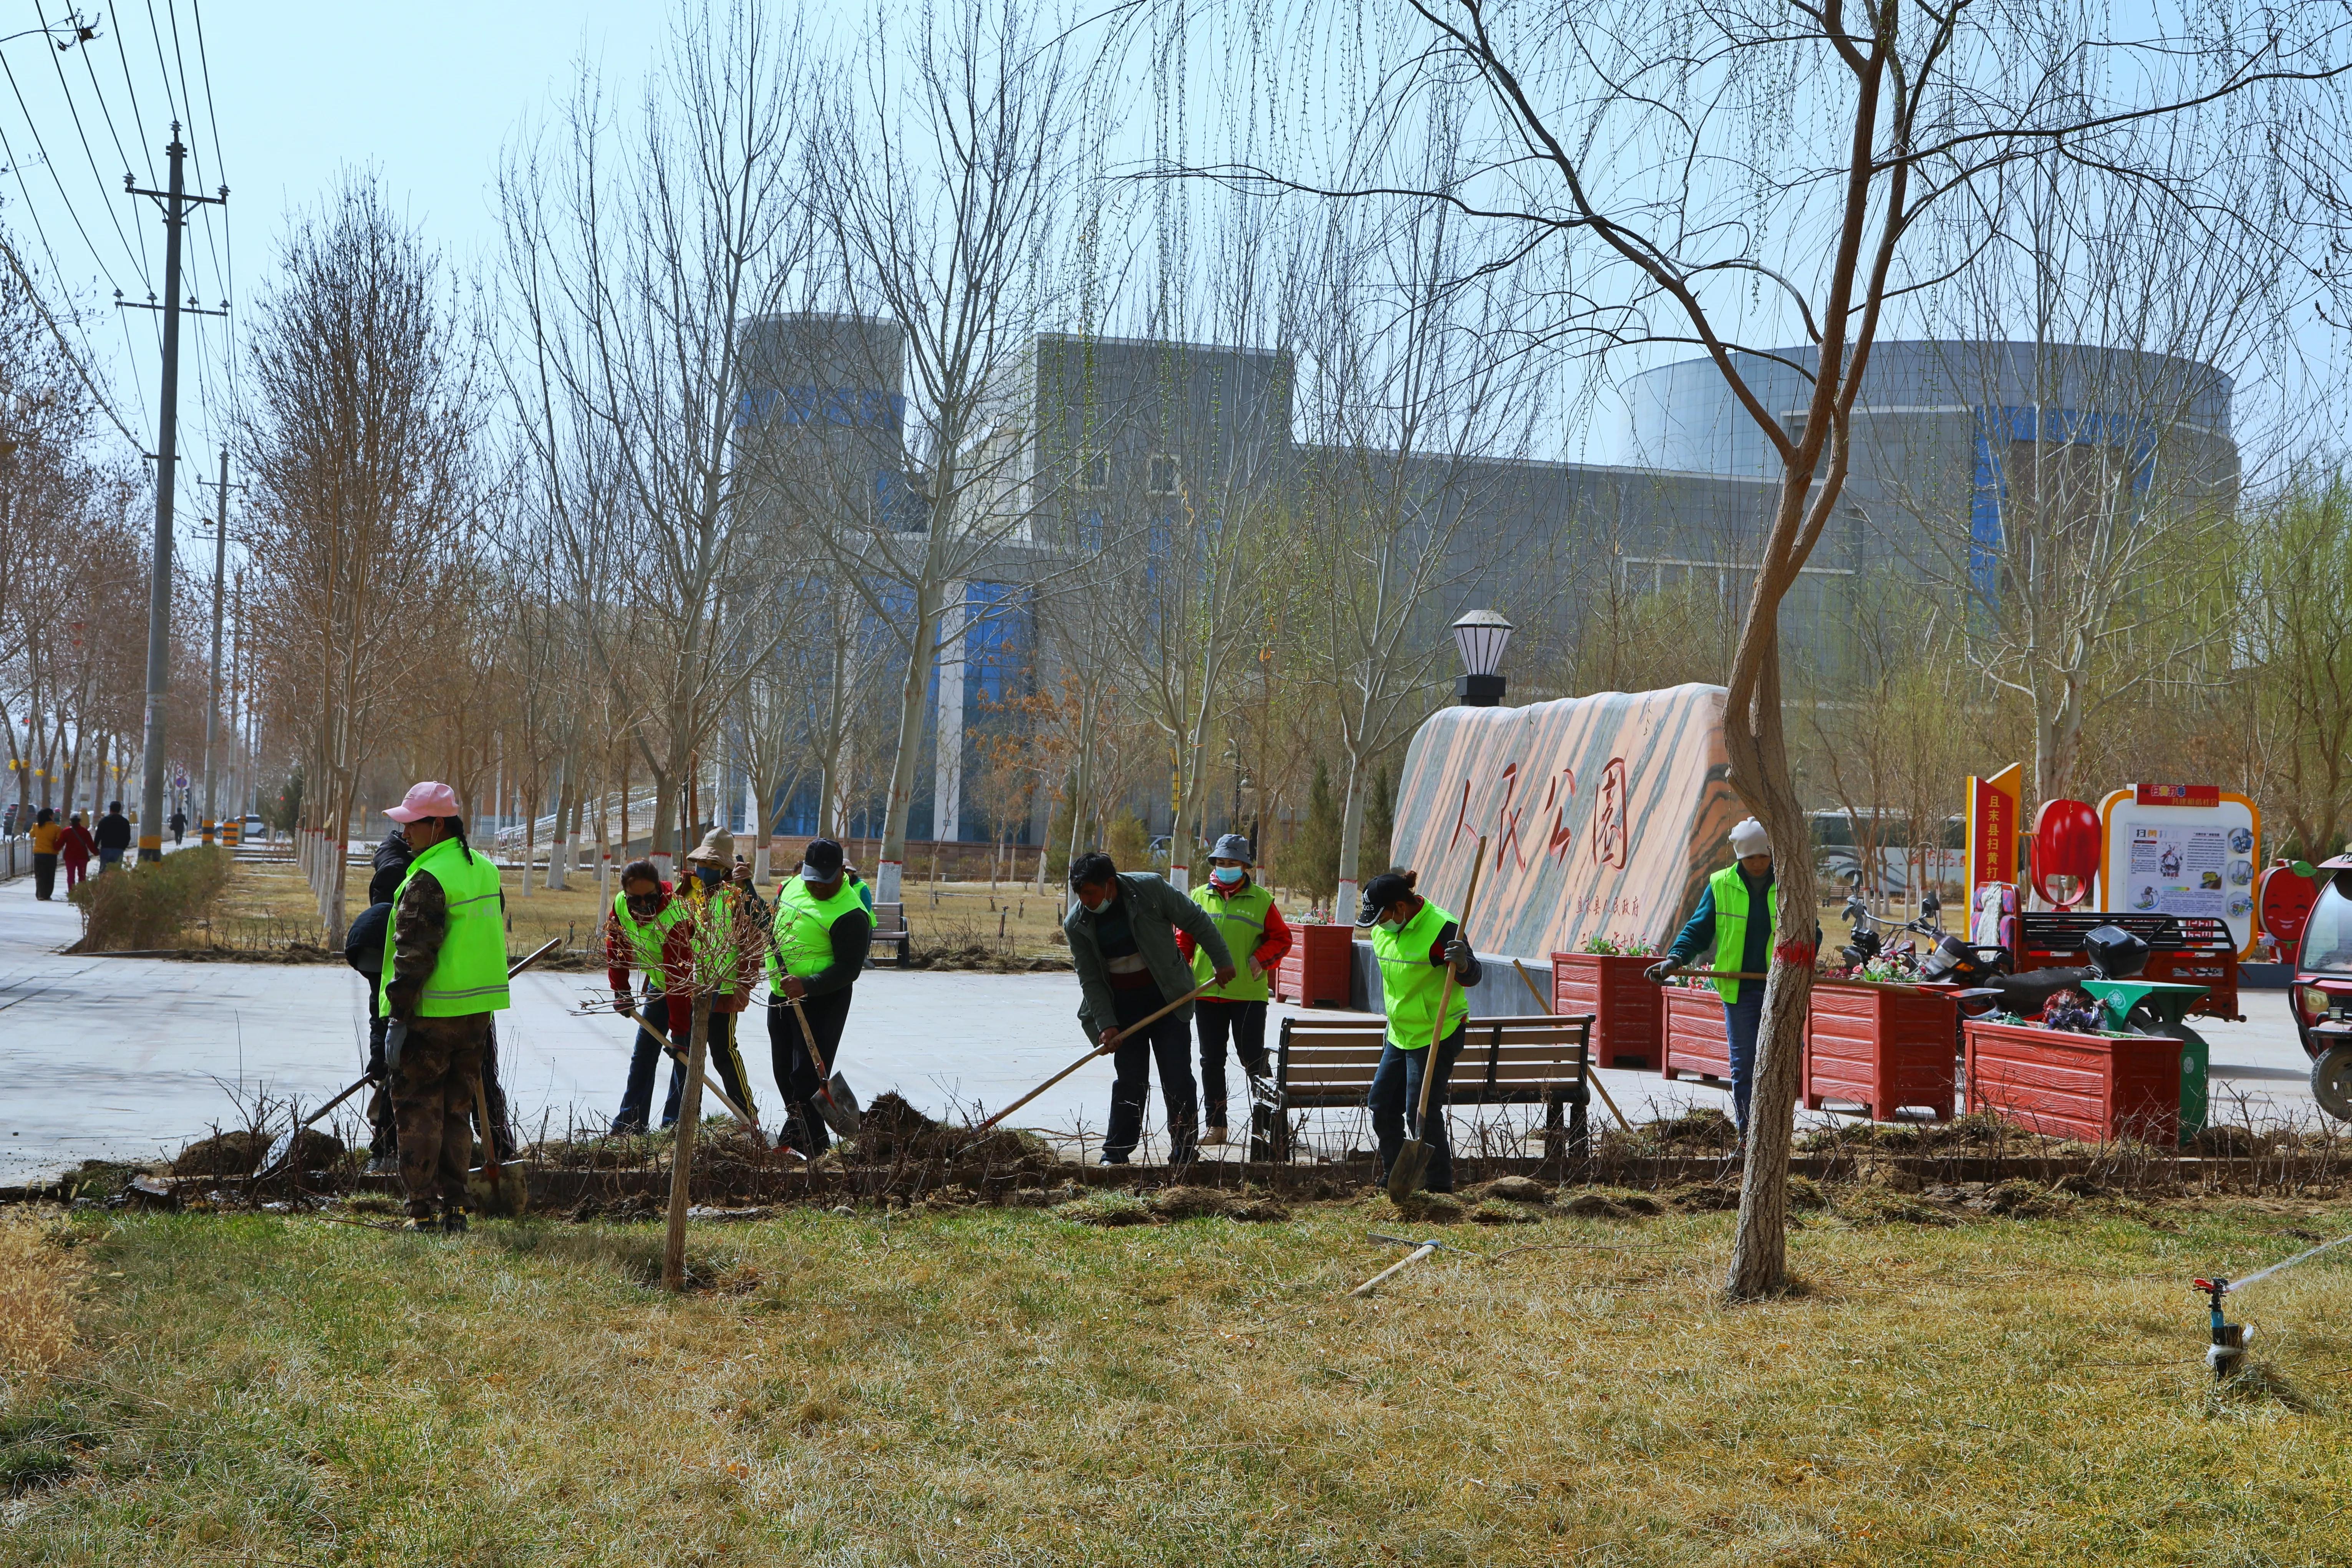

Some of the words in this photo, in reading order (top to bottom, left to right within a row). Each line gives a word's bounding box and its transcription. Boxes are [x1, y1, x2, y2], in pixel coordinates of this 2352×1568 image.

[1449, 757, 1627, 873] 人民公园
[1986, 796, 2000, 882] 且末县扫黄打
[1576, 895, 1639, 917] 且末县人民政府
